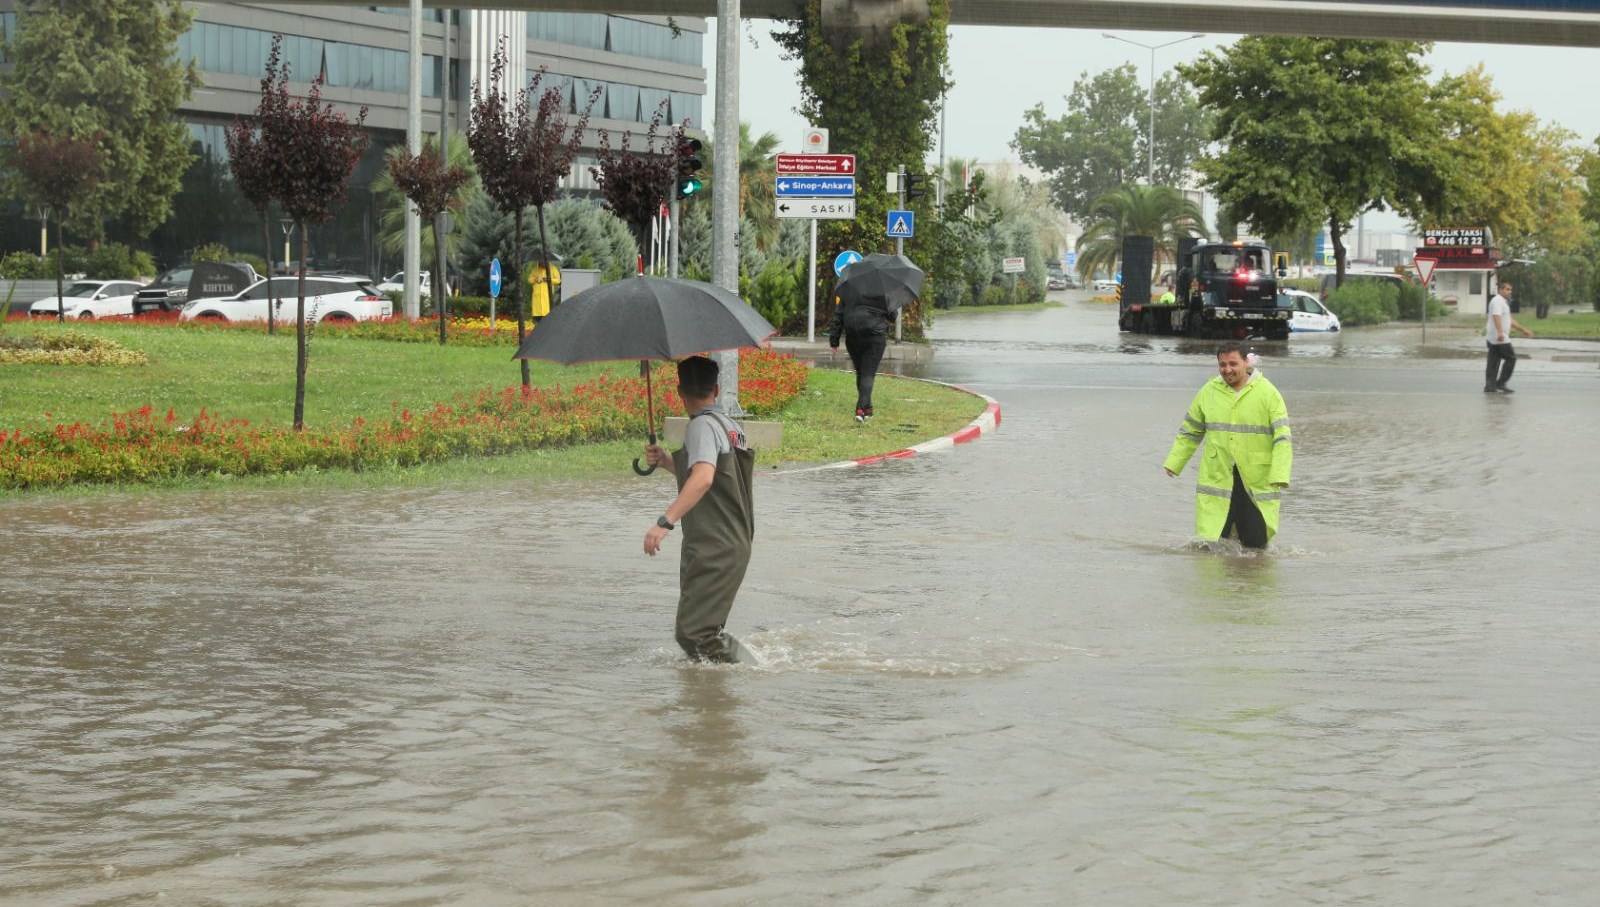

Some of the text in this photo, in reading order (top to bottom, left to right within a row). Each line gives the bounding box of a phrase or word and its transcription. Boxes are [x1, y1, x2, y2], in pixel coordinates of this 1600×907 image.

[792, 181, 853, 191] Sinop-Ankara
[1438, 237, 1483, 245] 446 12 22
[203, 284, 233, 292] RIHTIM
